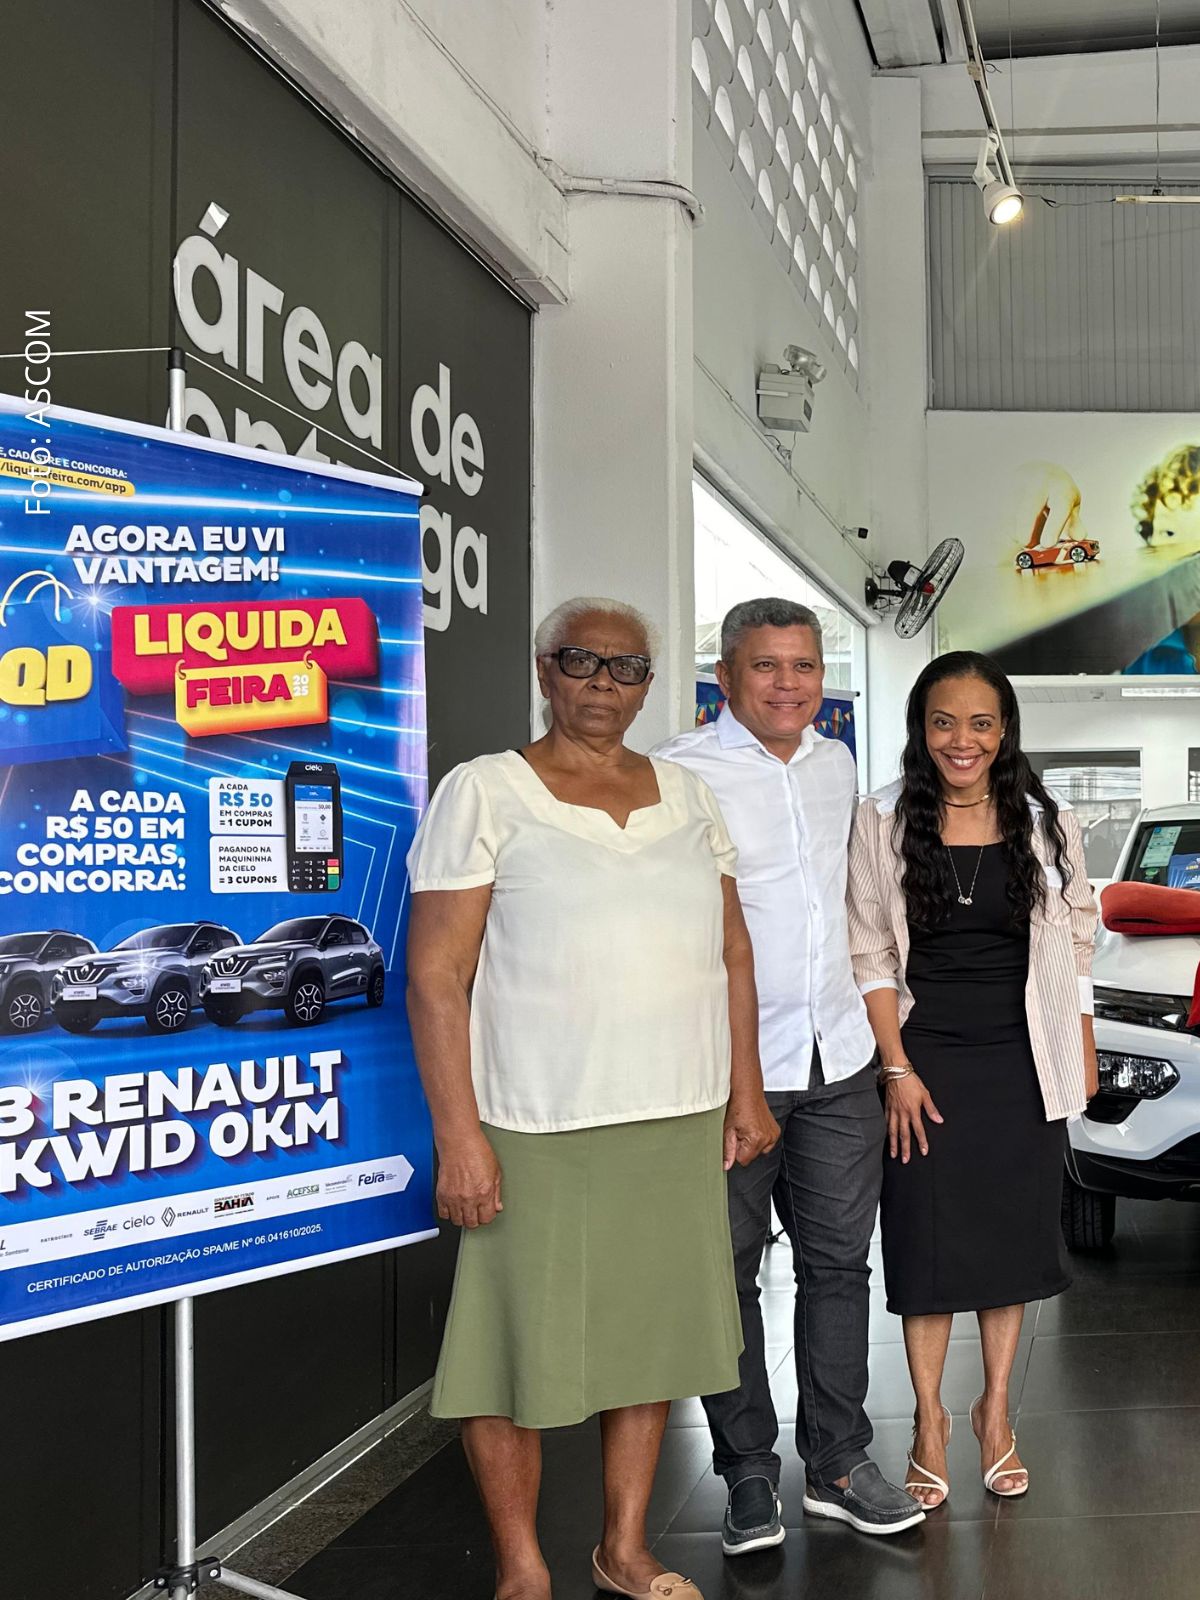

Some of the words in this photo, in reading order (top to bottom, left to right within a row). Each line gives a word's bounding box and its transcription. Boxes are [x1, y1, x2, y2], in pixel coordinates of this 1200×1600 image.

[173, 201, 382, 450] área
[410, 362, 485, 497] de
[71, 460, 128, 479] CONCORRA:
[65, 524, 197, 551] AGORA
[202, 526, 247, 551] EU
[250, 527, 285, 551] VI
[72, 555, 280, 584] VANTAGEM!
[134, 608, 348, 661] LIQUIDA
[186, 673, 293, 708] FEIRA
[69, 789, 95, 812] A
[99, 790, 186, 813] CADA
[219, 791, 244, 808] R$
[249, 793, 273, 807] 50
[46, 814, 89, 842] R$
[94, 816, 134, 839] 50
[140, 817, 185, 839] EM
[228, 819, 233, 827] 1
[235, 819, 272, 827] CUPOM
[16, 842, 186, 870] COMPRAS,
[219, 855, 272, 863] MAQUININHA
[227, 876, 233, 884] 3
[235, 876, 277, 884] CUPONS
[0, 1086, 35, 1136] 3
[53, 1050, 342, 1130] RENAULT
[0, 1119, 196, 1193] KWID
[358, 1172, 385, 1186] Feira
[177, 1207, 209, 1218] RENAULT
[214, 1196, 254, 1213] BAHIA
[83, 1223, 118, 1237] SEBRAE
[123, 1214, 156, 1230] cielo
[27, 1268, 106, 1293] CERTIFICADO
[108, 1264, 124, 1277] DE
[125, 1245, 201, 1273] AUTORIZAÇÃO
[202, 1240, 240, 1256] SPA/ME
[255, 1223, 324, 1245] 06.041610/2025.
